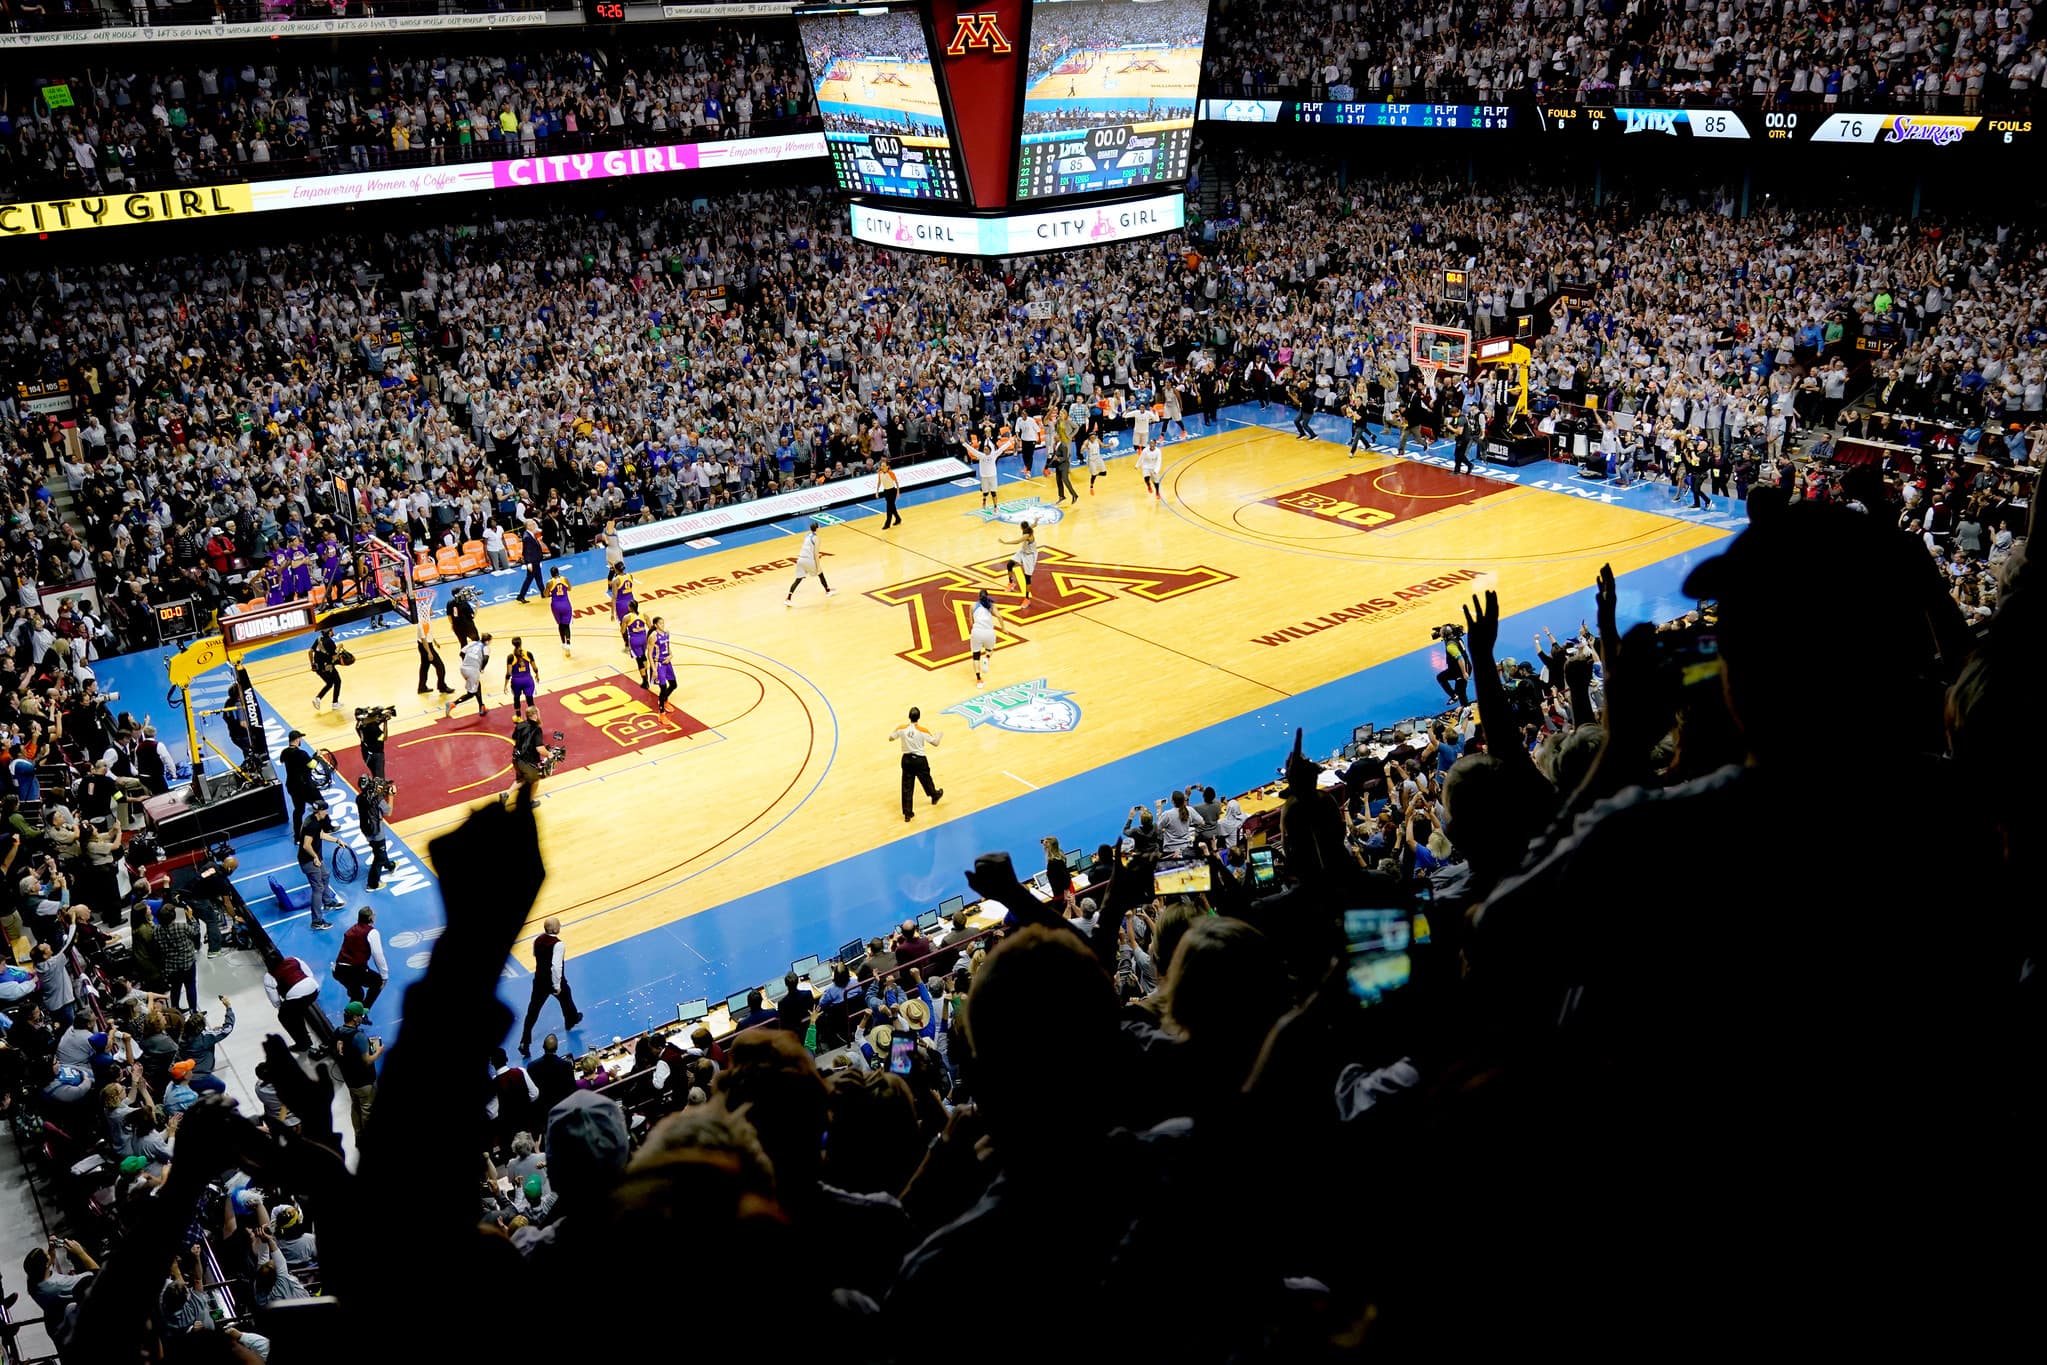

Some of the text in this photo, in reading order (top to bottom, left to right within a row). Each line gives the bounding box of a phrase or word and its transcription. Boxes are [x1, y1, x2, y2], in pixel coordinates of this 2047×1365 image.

[597, 4, 623, 18] 9:26
[112, 30, 137, 39] HOUSE
[947, 14, 1011, 55] M
[1356, 115, 1365, 124] 17
[1547, 109, 1577, 119] FOULS
[1587, 109, 1607, 119] TOL
[1765, 112, 1797, 128] 00.0
[1592, 120, 1599, 130] 0
[1624, 110, 1680, 136] LYNX
[1705, 116, 1726, 133] 85
[1840, 120, 1862, 137] 76
[1988, 120, 2032, 132] FOULS
[1161, 129, 1190, 140] 1 4 14
[1787, 130, 1793, 139] 4
[1884, 115, 1966, 146] SPARKS
[1095, 128, 1126, 148] 00.0
[1181, 140, 1187, 148] 7
[729, 143, 782, 160] Empowering
[785, 141, 813, 153] Women
[875, 137, 899, 155] 00.0
[1036, 145, 1042, 154] 0
[1048, 144, 1054, 153] 0
[1022, 157, 1031, 166] 13
[1046, 154, 1055, 163] 17
[1132, 152, 1145, 164] 76
[1158, 152, 1164, 160] 3
[508, 145, 686, 186] CITY GIRL
[1020, 168, 1030, 176] 22
[1070, 159, 1083, 171] 85
[1103, 160, 1110, 171] 4
[1156, 161, 1173, 170] 12 1
[293, 173, 456, 200] Empowering Women of Coffee
[0, 187, 234, 232] CITY GIRL
[866, 217, 954, 242] CITY GIRL
[1037, 208, 1157, 239] CITY GIRL
[46, 382, 58, 391] 105
[1528, 479, 1624, 503] LYNX
[1250, 568, 1487, 647] WILLIAMS ARENA
[1357, 611, 1386, 625] THE
[243, 688, 259, 726] verizon
